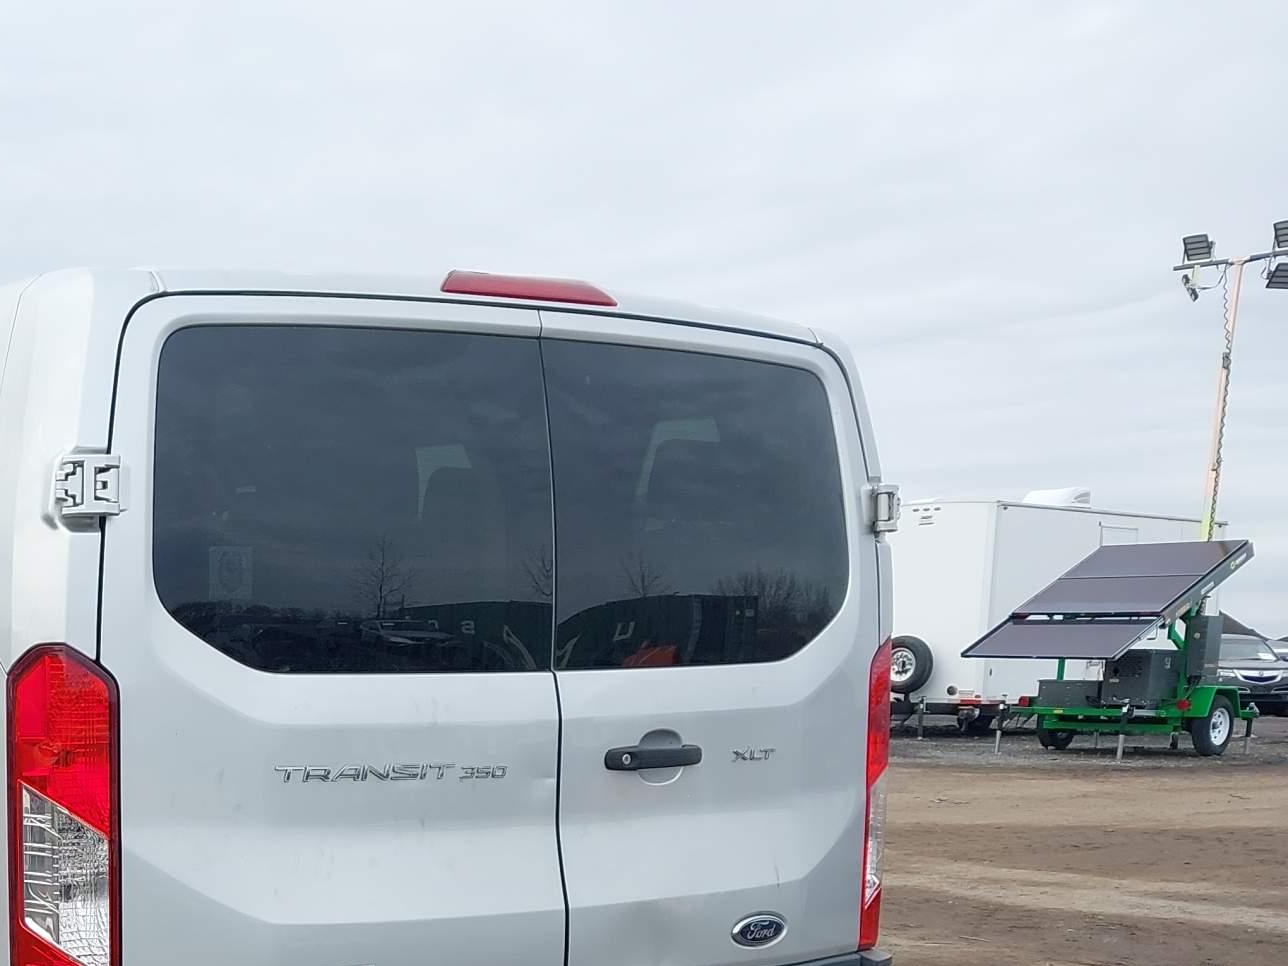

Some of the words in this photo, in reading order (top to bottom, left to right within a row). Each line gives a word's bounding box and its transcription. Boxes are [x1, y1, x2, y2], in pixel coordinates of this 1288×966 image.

[731, 746, 777, 763] XLT
[274, 763, 456, 783] TRANSIT
[459, 765, 508, 780] 350
[746, 920, 777, 940] Ford
